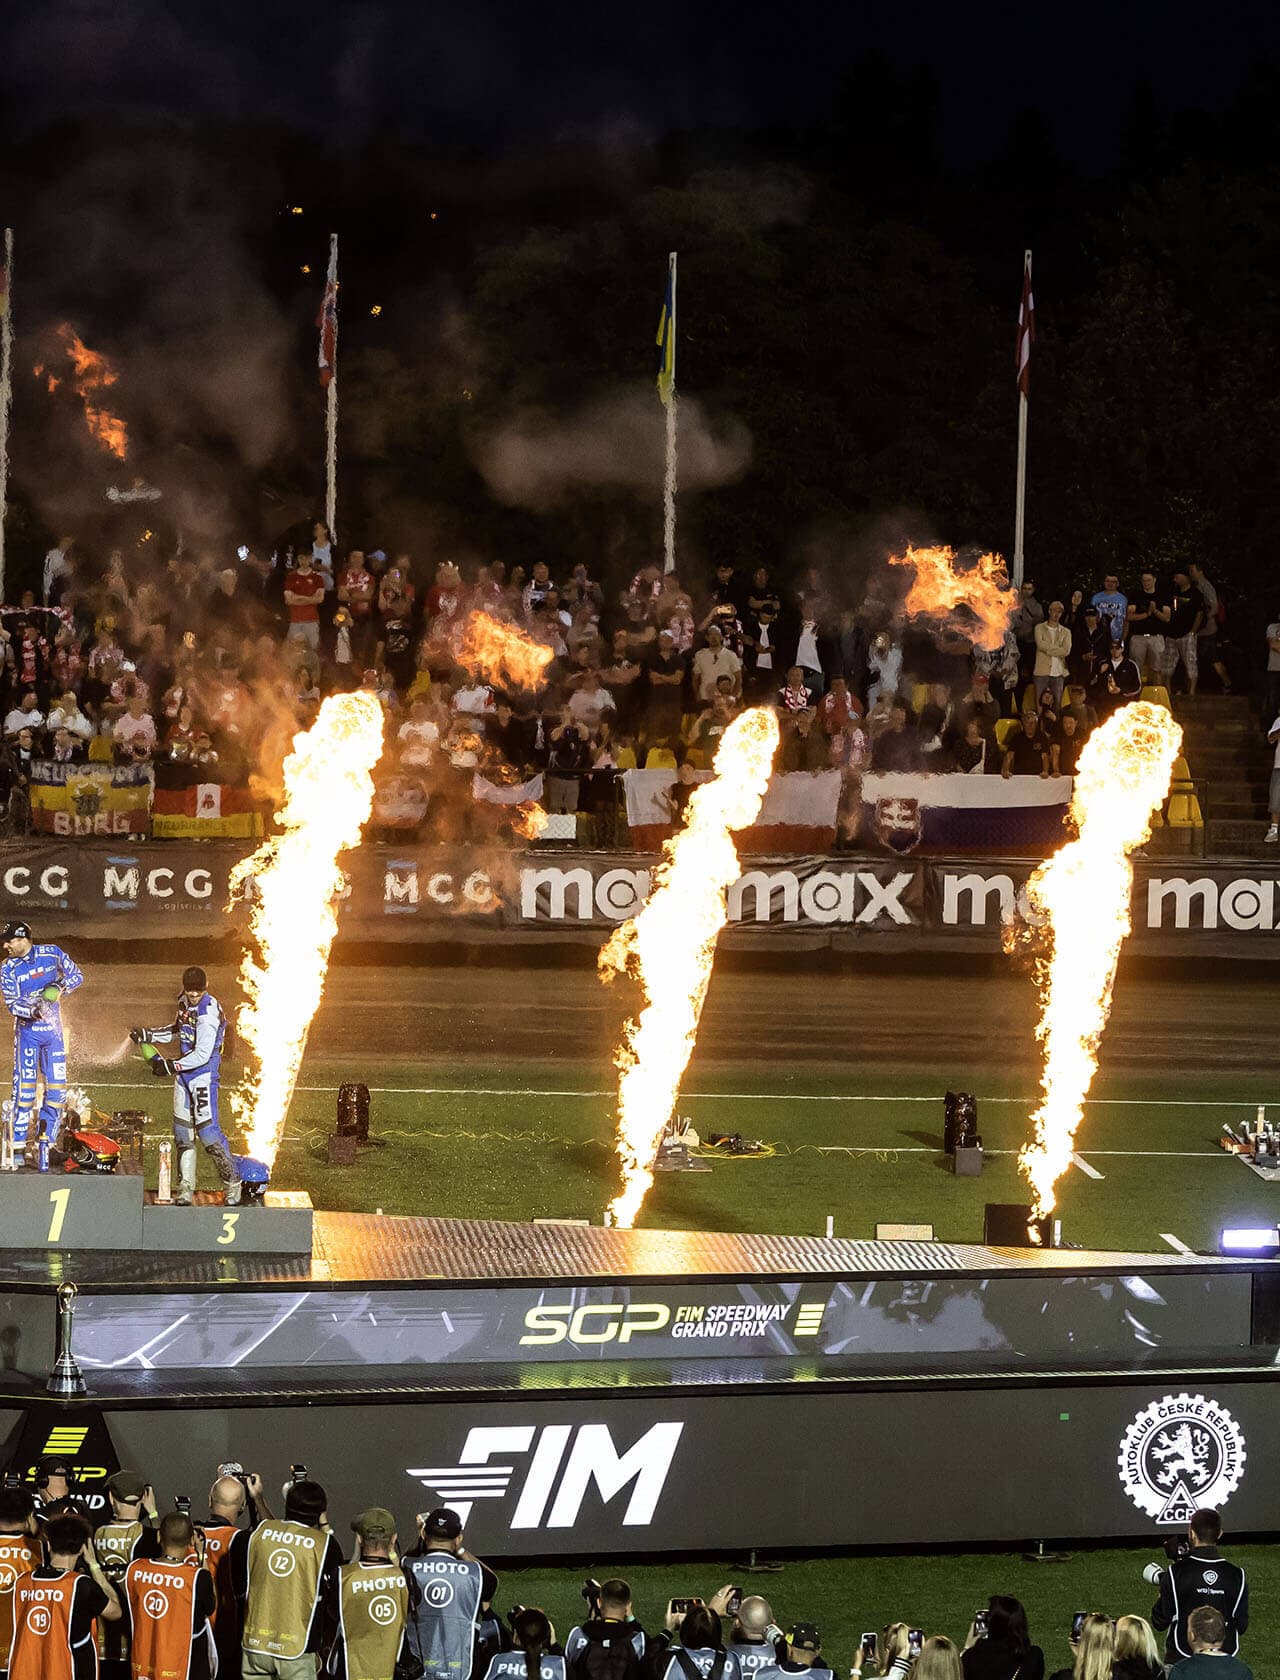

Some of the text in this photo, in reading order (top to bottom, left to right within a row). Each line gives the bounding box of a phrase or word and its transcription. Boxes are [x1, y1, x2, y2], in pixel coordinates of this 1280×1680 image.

[103, 866, 213, 899] MCG
[384, 870, 492, 904] MCG
[520, 867, 651, 920] ma
[727, 871, 914, 924] max
[1147, 878, 1280, 931] ma
[47, 1189, 71, 1243] 1
[217, 1213, 241, 1244] 3
[675, 1304, 792, 1323] FIM SPEEDWAY
[520, 1303, 671, 1345] SGP
[671, 1320, 770, 1338] GRAND PRIX
[1127, 1403, 1237, 1485] AUTOKLUB ČESKÉ REPUBLIKY
[406, 1422, 684, 1529] FIM
[261, 1528, 316, 1549] PHOTO
[274, 1556, 289, 1570] 12
[411, 1562, 470, 1575] PHOTO
[133, 1570, 185, 1589] PHOTO
[352, 1576, 406, 1594] PHOTO
[20, 1589, 64, 1602] PHOTO
[431, 1586, 448, 1601] 01
[148, 1596, 164, 1612] 20
[375, 1603, 391, 1618] 05
[33, 1614, 47, 1627] 19
[497, 1663, 554, 1680] PHOO
